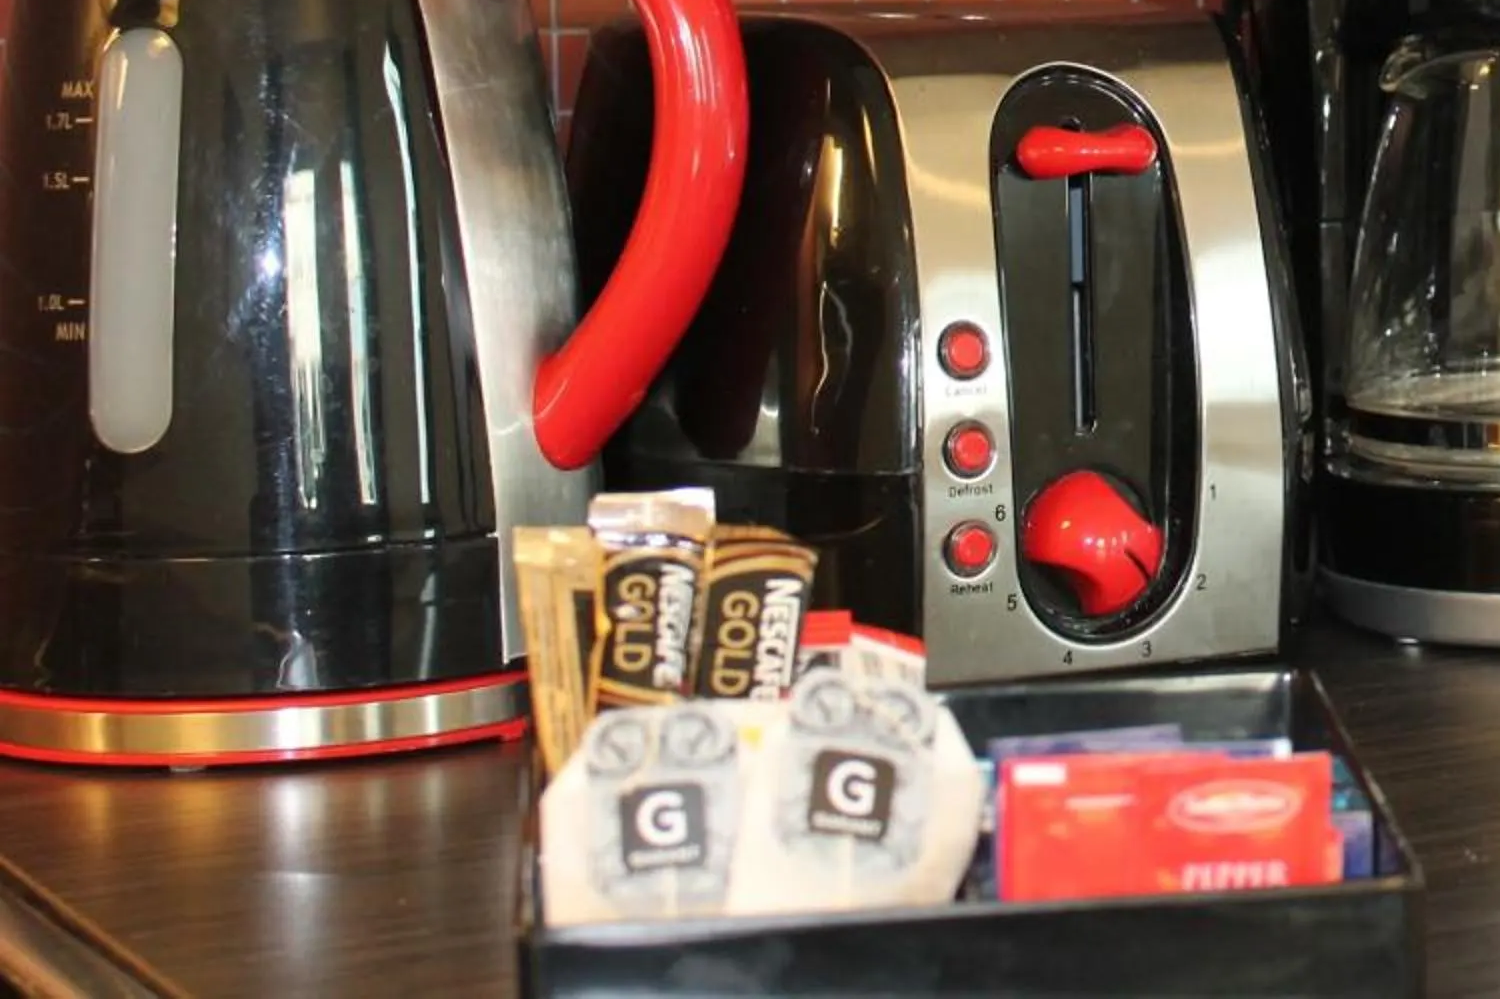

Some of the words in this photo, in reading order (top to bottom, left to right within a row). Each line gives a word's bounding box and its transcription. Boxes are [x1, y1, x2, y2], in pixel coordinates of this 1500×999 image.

[61, 81, 95, 99] MAX
[55, 322, 87, 342] MIN
[948, 483, 994, 498] Defrost
[1209, 484, 1217, 500] 1
[995, 505, 1006, 522] 6
[949, 583, 994, 594] Reheat
[1195, 574, 1207, 591] 2
[1007, 595, 1017, 612] 5
[613, 574, 655, 671] GOLD
[711, 591, 759, 694] GOLD
[1142, 641, 1152, 658] 3
[1062, 649, 1073, 666] 4
[827, 760, 877, 816] G
[636, 791, 687, 845] G
